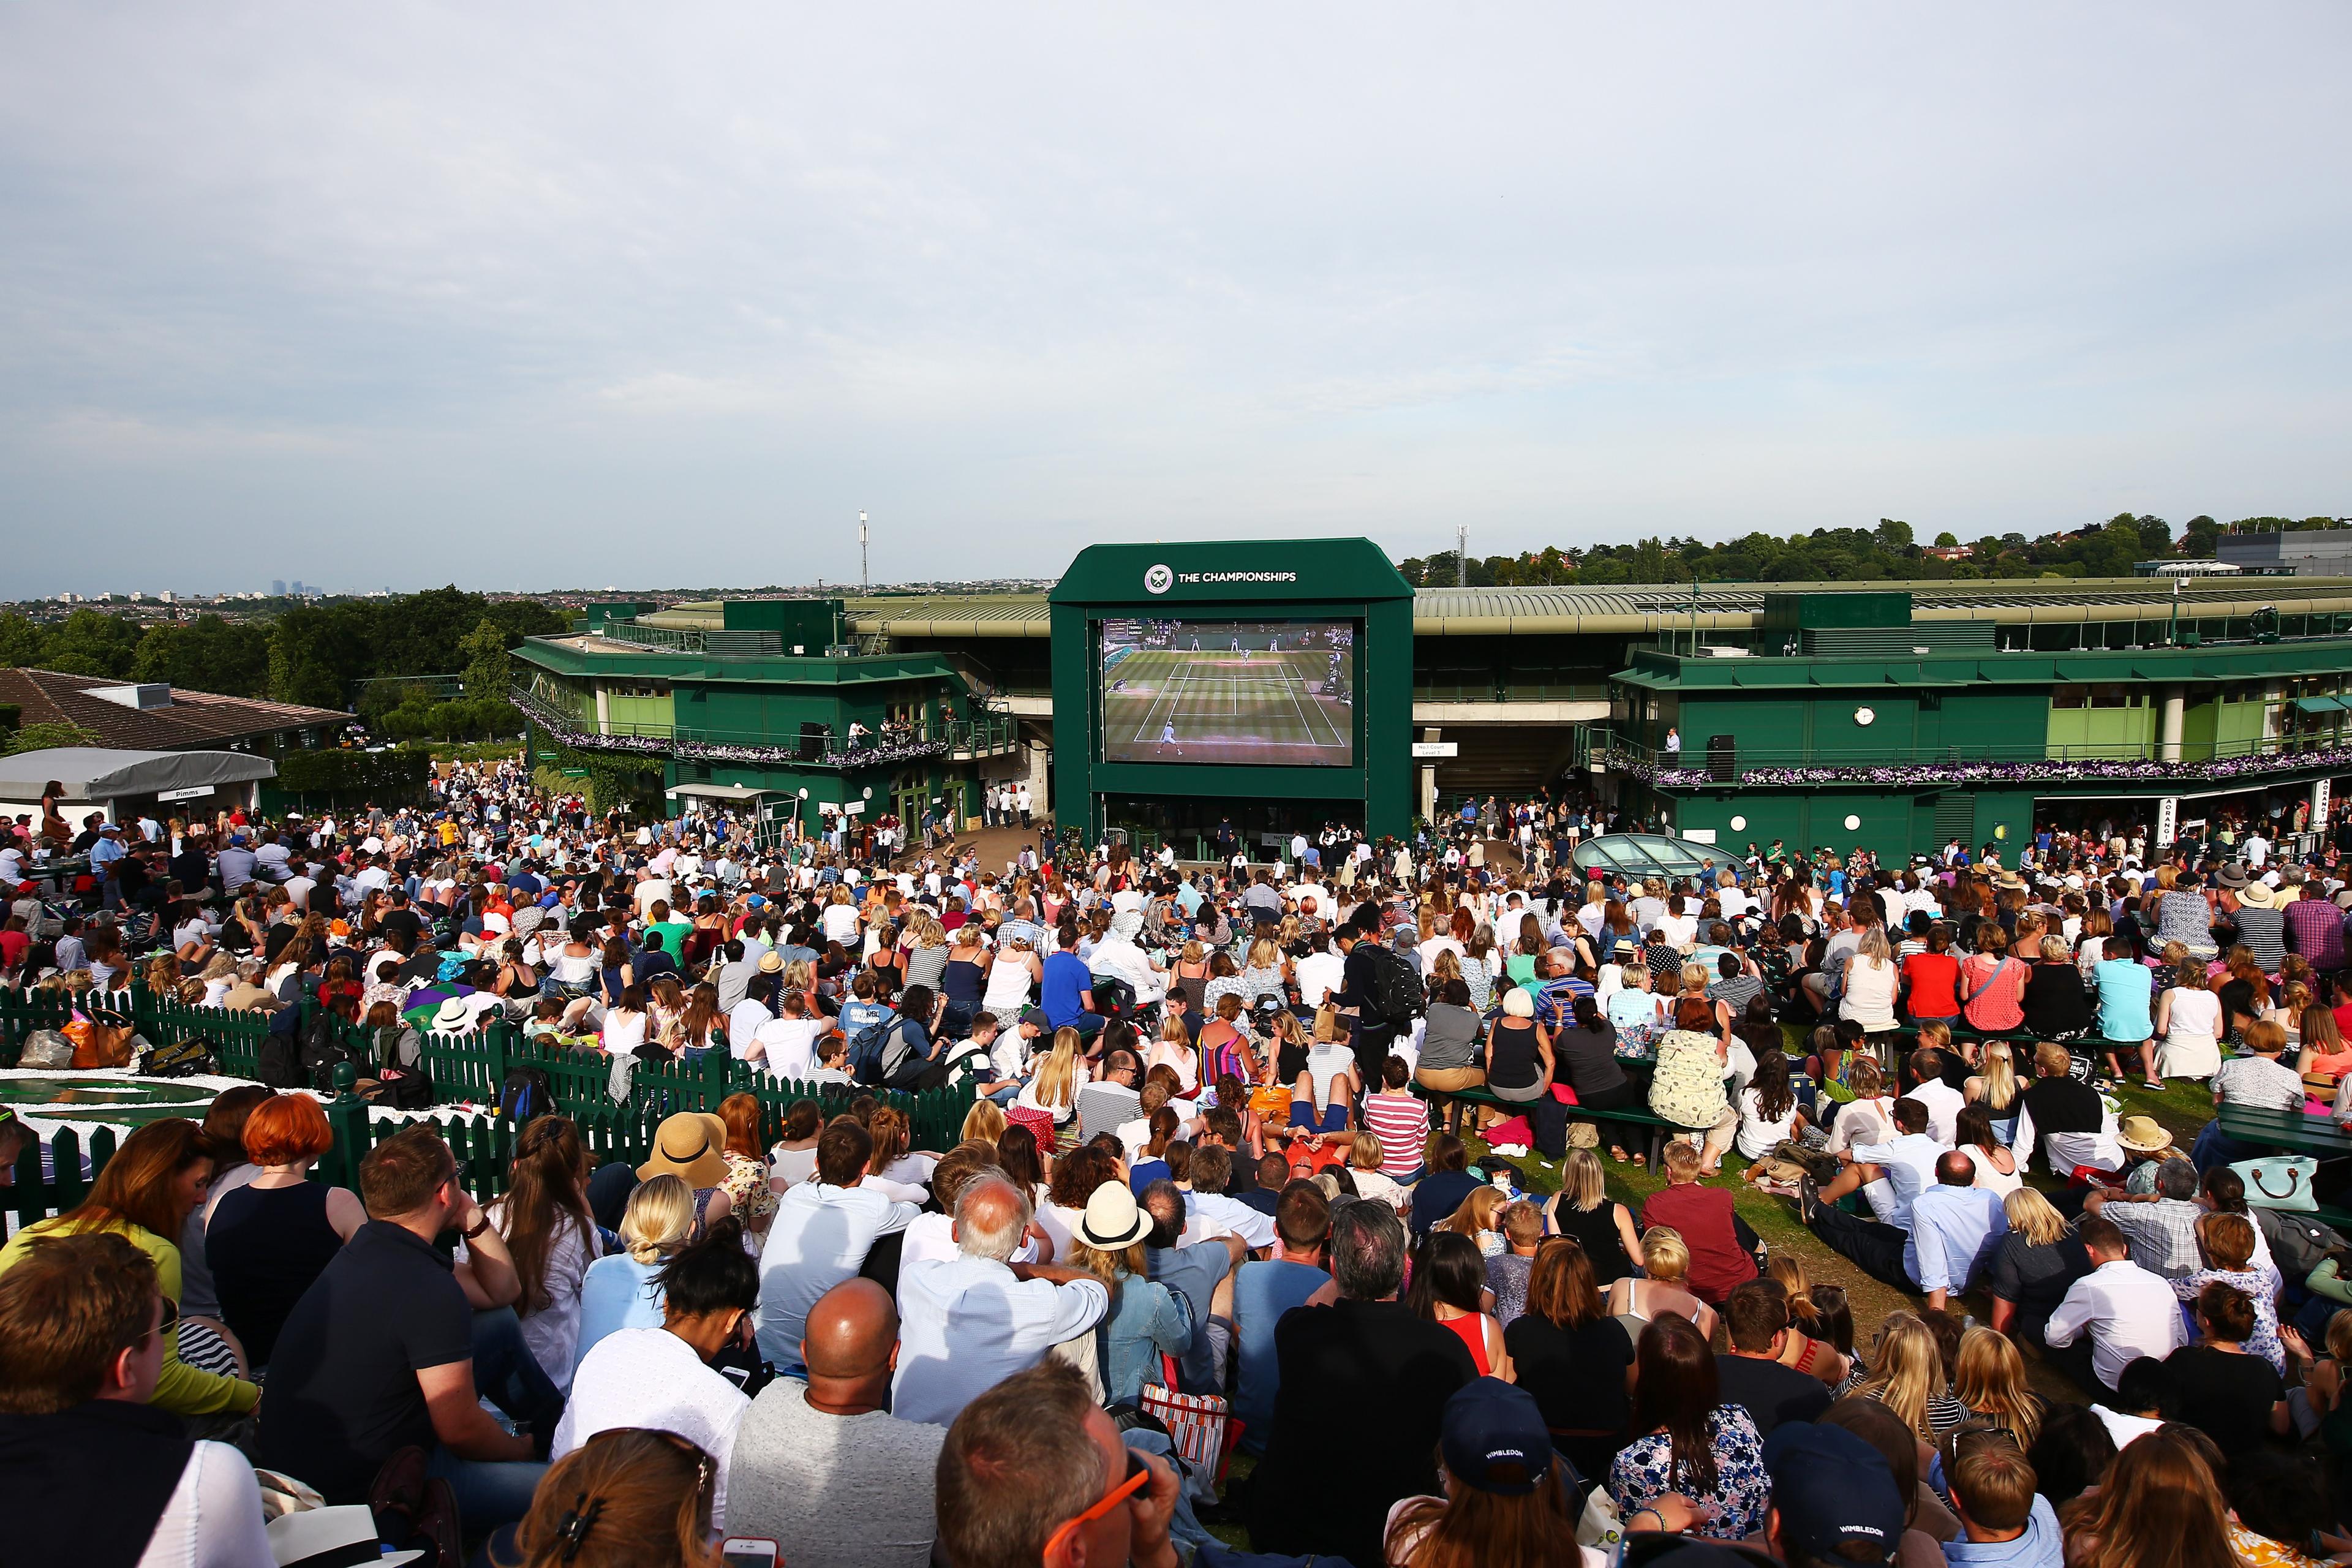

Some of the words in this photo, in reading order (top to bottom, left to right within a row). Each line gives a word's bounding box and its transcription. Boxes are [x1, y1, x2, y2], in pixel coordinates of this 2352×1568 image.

[1178, 573, 1200, 582] THE
[1202, 572, 1297, 582] CHAMPIONSHIPS
[1485, 1449, 1523, 1459] WIMBLEDON
[1839, 1525, 1883, 1537] WIMBLEDON
